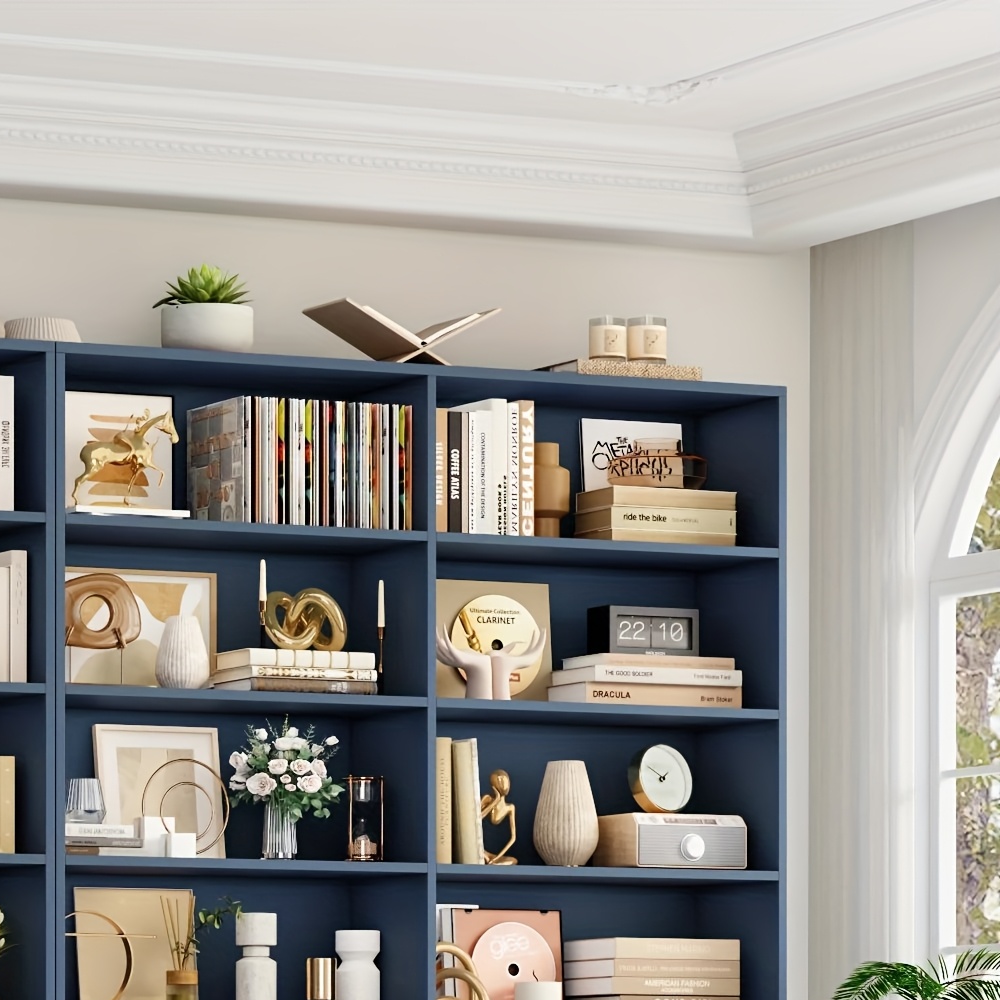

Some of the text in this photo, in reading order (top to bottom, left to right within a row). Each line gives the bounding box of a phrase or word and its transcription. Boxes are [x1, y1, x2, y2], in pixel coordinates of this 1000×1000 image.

[450, 448, 460, 500] COFFEE ATLAS
[480, 478, 486, 486] OF
[623, 512, 667, 522] ride the bike
[476, 616, 516, 624] CLARINET
[618, 620, 684, 642] 22 10
[592, 690, 631, 700] DRACULA
[644, 979, 710, 988] AMERICAN FASHION
